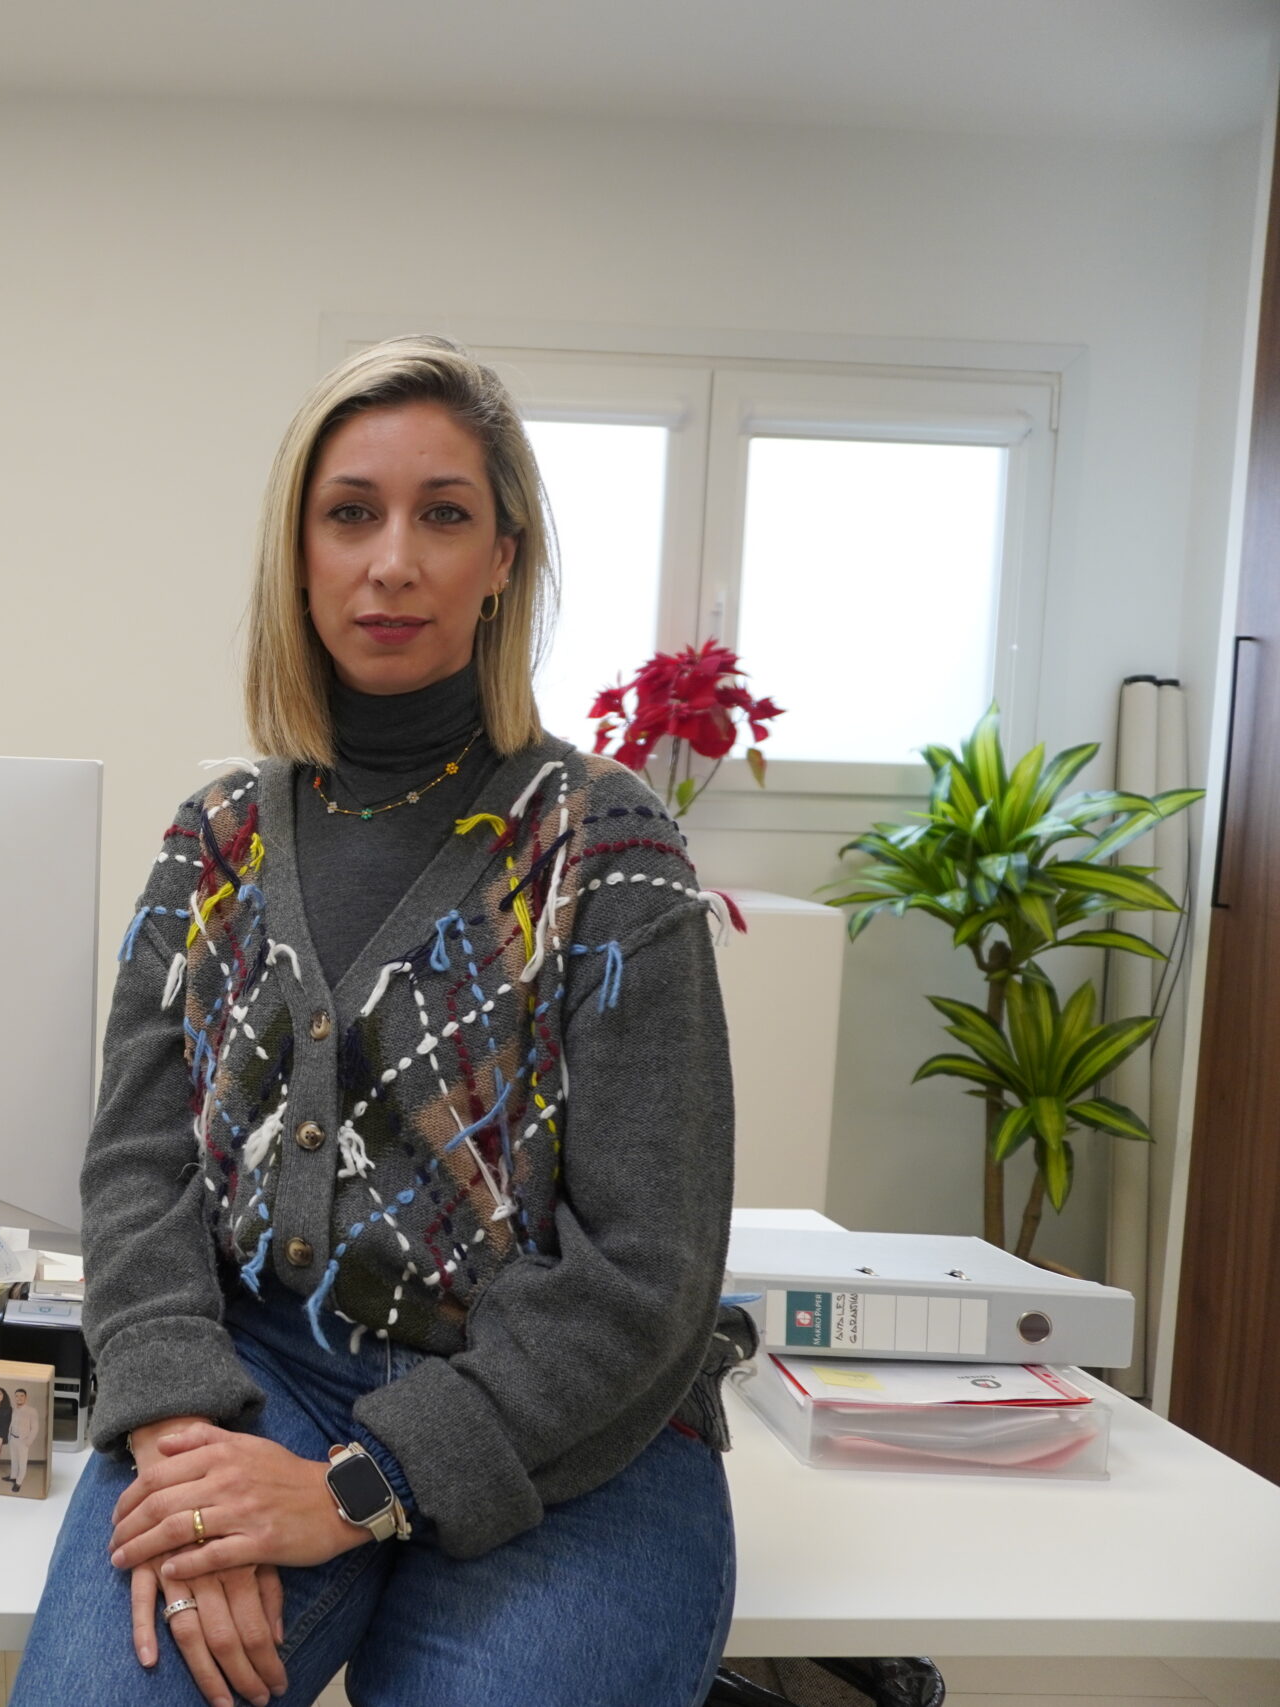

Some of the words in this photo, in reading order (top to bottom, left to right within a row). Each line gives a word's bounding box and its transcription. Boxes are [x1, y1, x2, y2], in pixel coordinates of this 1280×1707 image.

[814, 1294, 823, 1317] PAPER
[834, 1294, 846, 1341] AVALES
[812, 1317, 822, 1346] MAKRO
